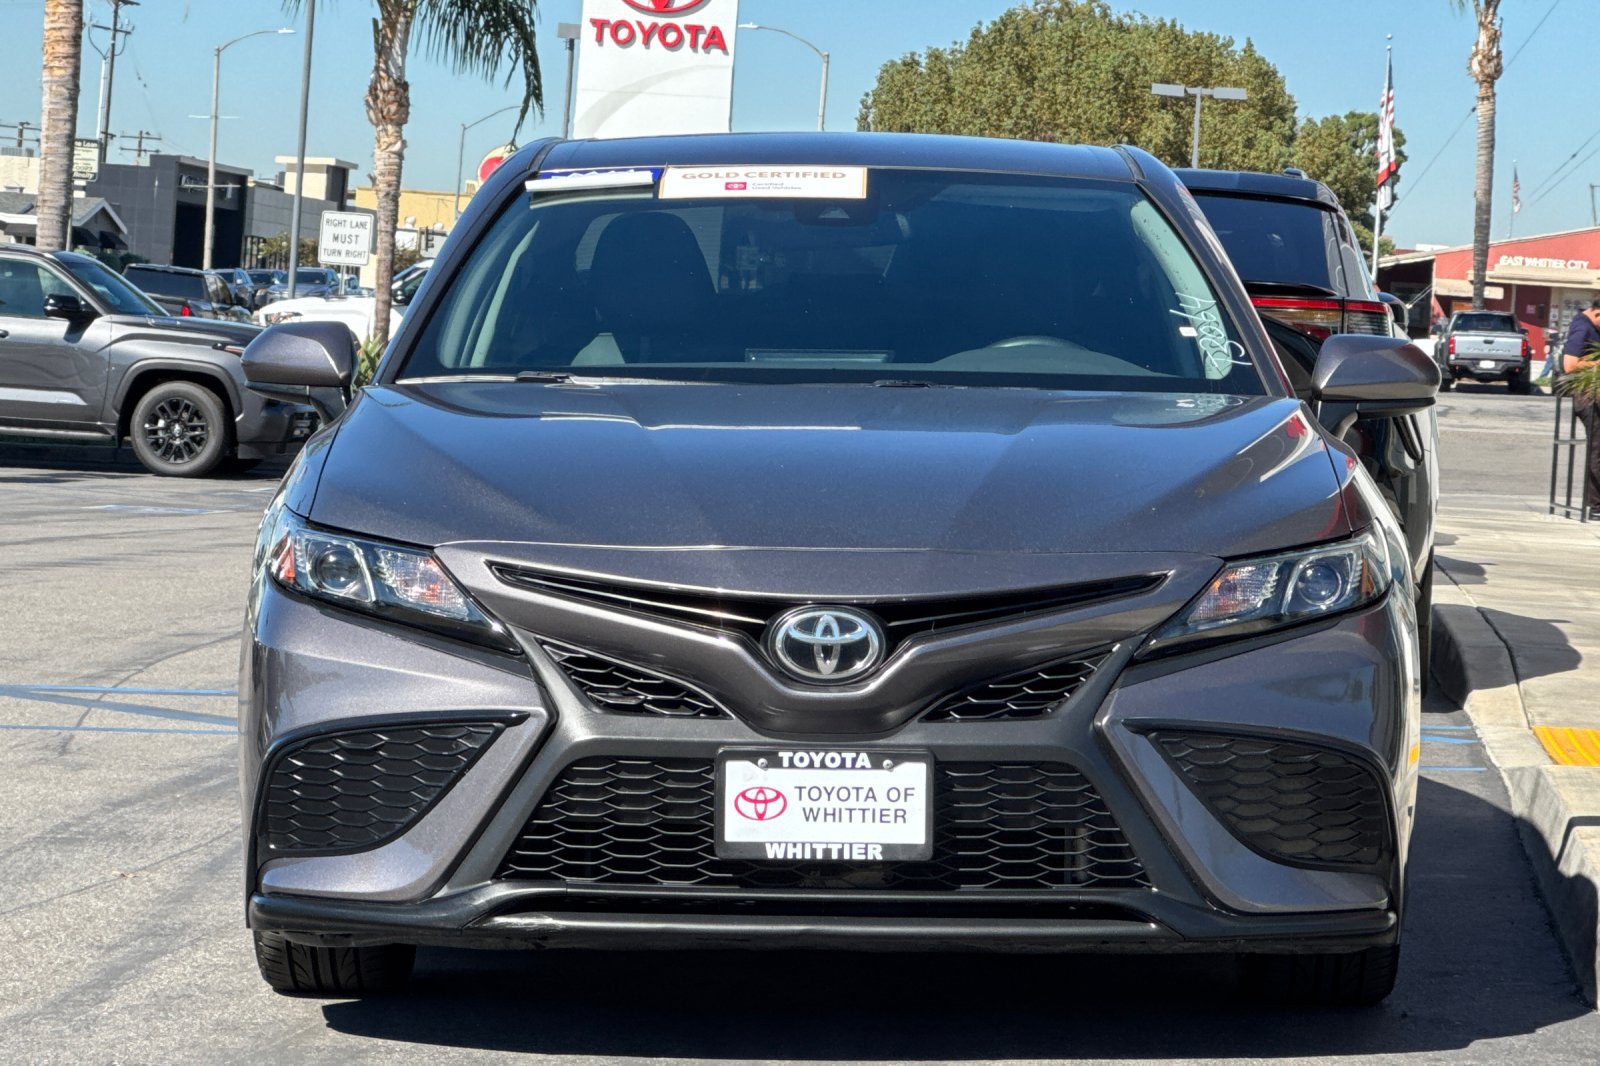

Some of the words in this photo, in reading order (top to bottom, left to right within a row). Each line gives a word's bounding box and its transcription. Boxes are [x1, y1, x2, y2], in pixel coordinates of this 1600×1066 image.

[590, 18, 729, 55] TOYOTA
[681, 171, 740, 180] GOLD
[744, 171, 847, 179] CERTIFIED
[325, 218, 347, 229] RIGHT
[350, 220, 368, 230] LANE
[332, 233, 360, 245] MUST
[323, 247, 342, 258] TURN
[345, 249, 367, 259] RIGHT
[1499, 255, 1524, 266] EAST
[1524, 257, 1566, 269] WHITTIER
[1566, 260, 1590, 270] CITY
[778, 751, 872, 769] TOYOTA
[794, 785, 878, 803] TOYOTA
[886, 786, 916, 803] OF
[802, 807, 907, 824] WHITTIER
[765, 842, 883, 860] WHITTIER
